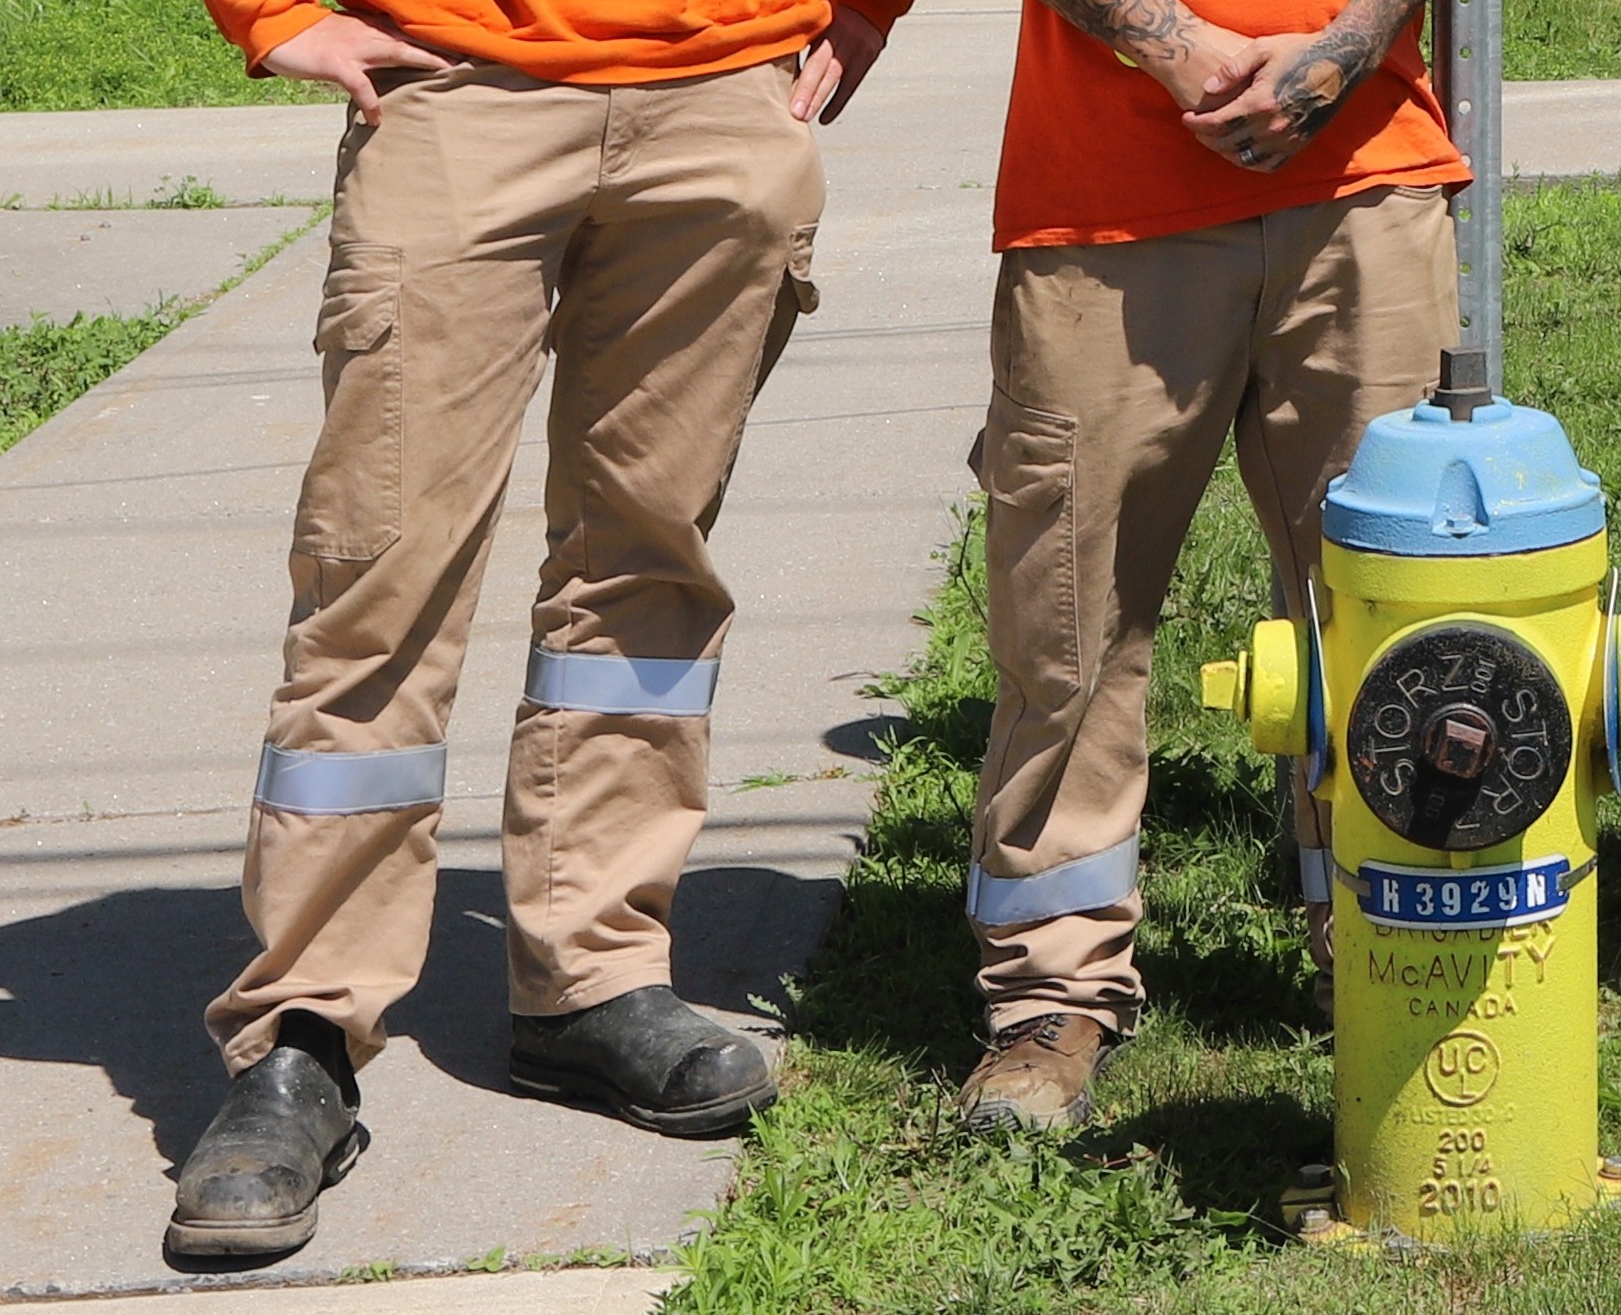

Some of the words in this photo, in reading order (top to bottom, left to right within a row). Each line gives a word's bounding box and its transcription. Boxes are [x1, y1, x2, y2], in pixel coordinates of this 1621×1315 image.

[1368, 653, 1470, 797] STORZ
[1408, 992, 1519, 1020] CANADA
[1438, 1127, 1487, 1153] 200
[1418, 1178, 1501, 1216] 2010
